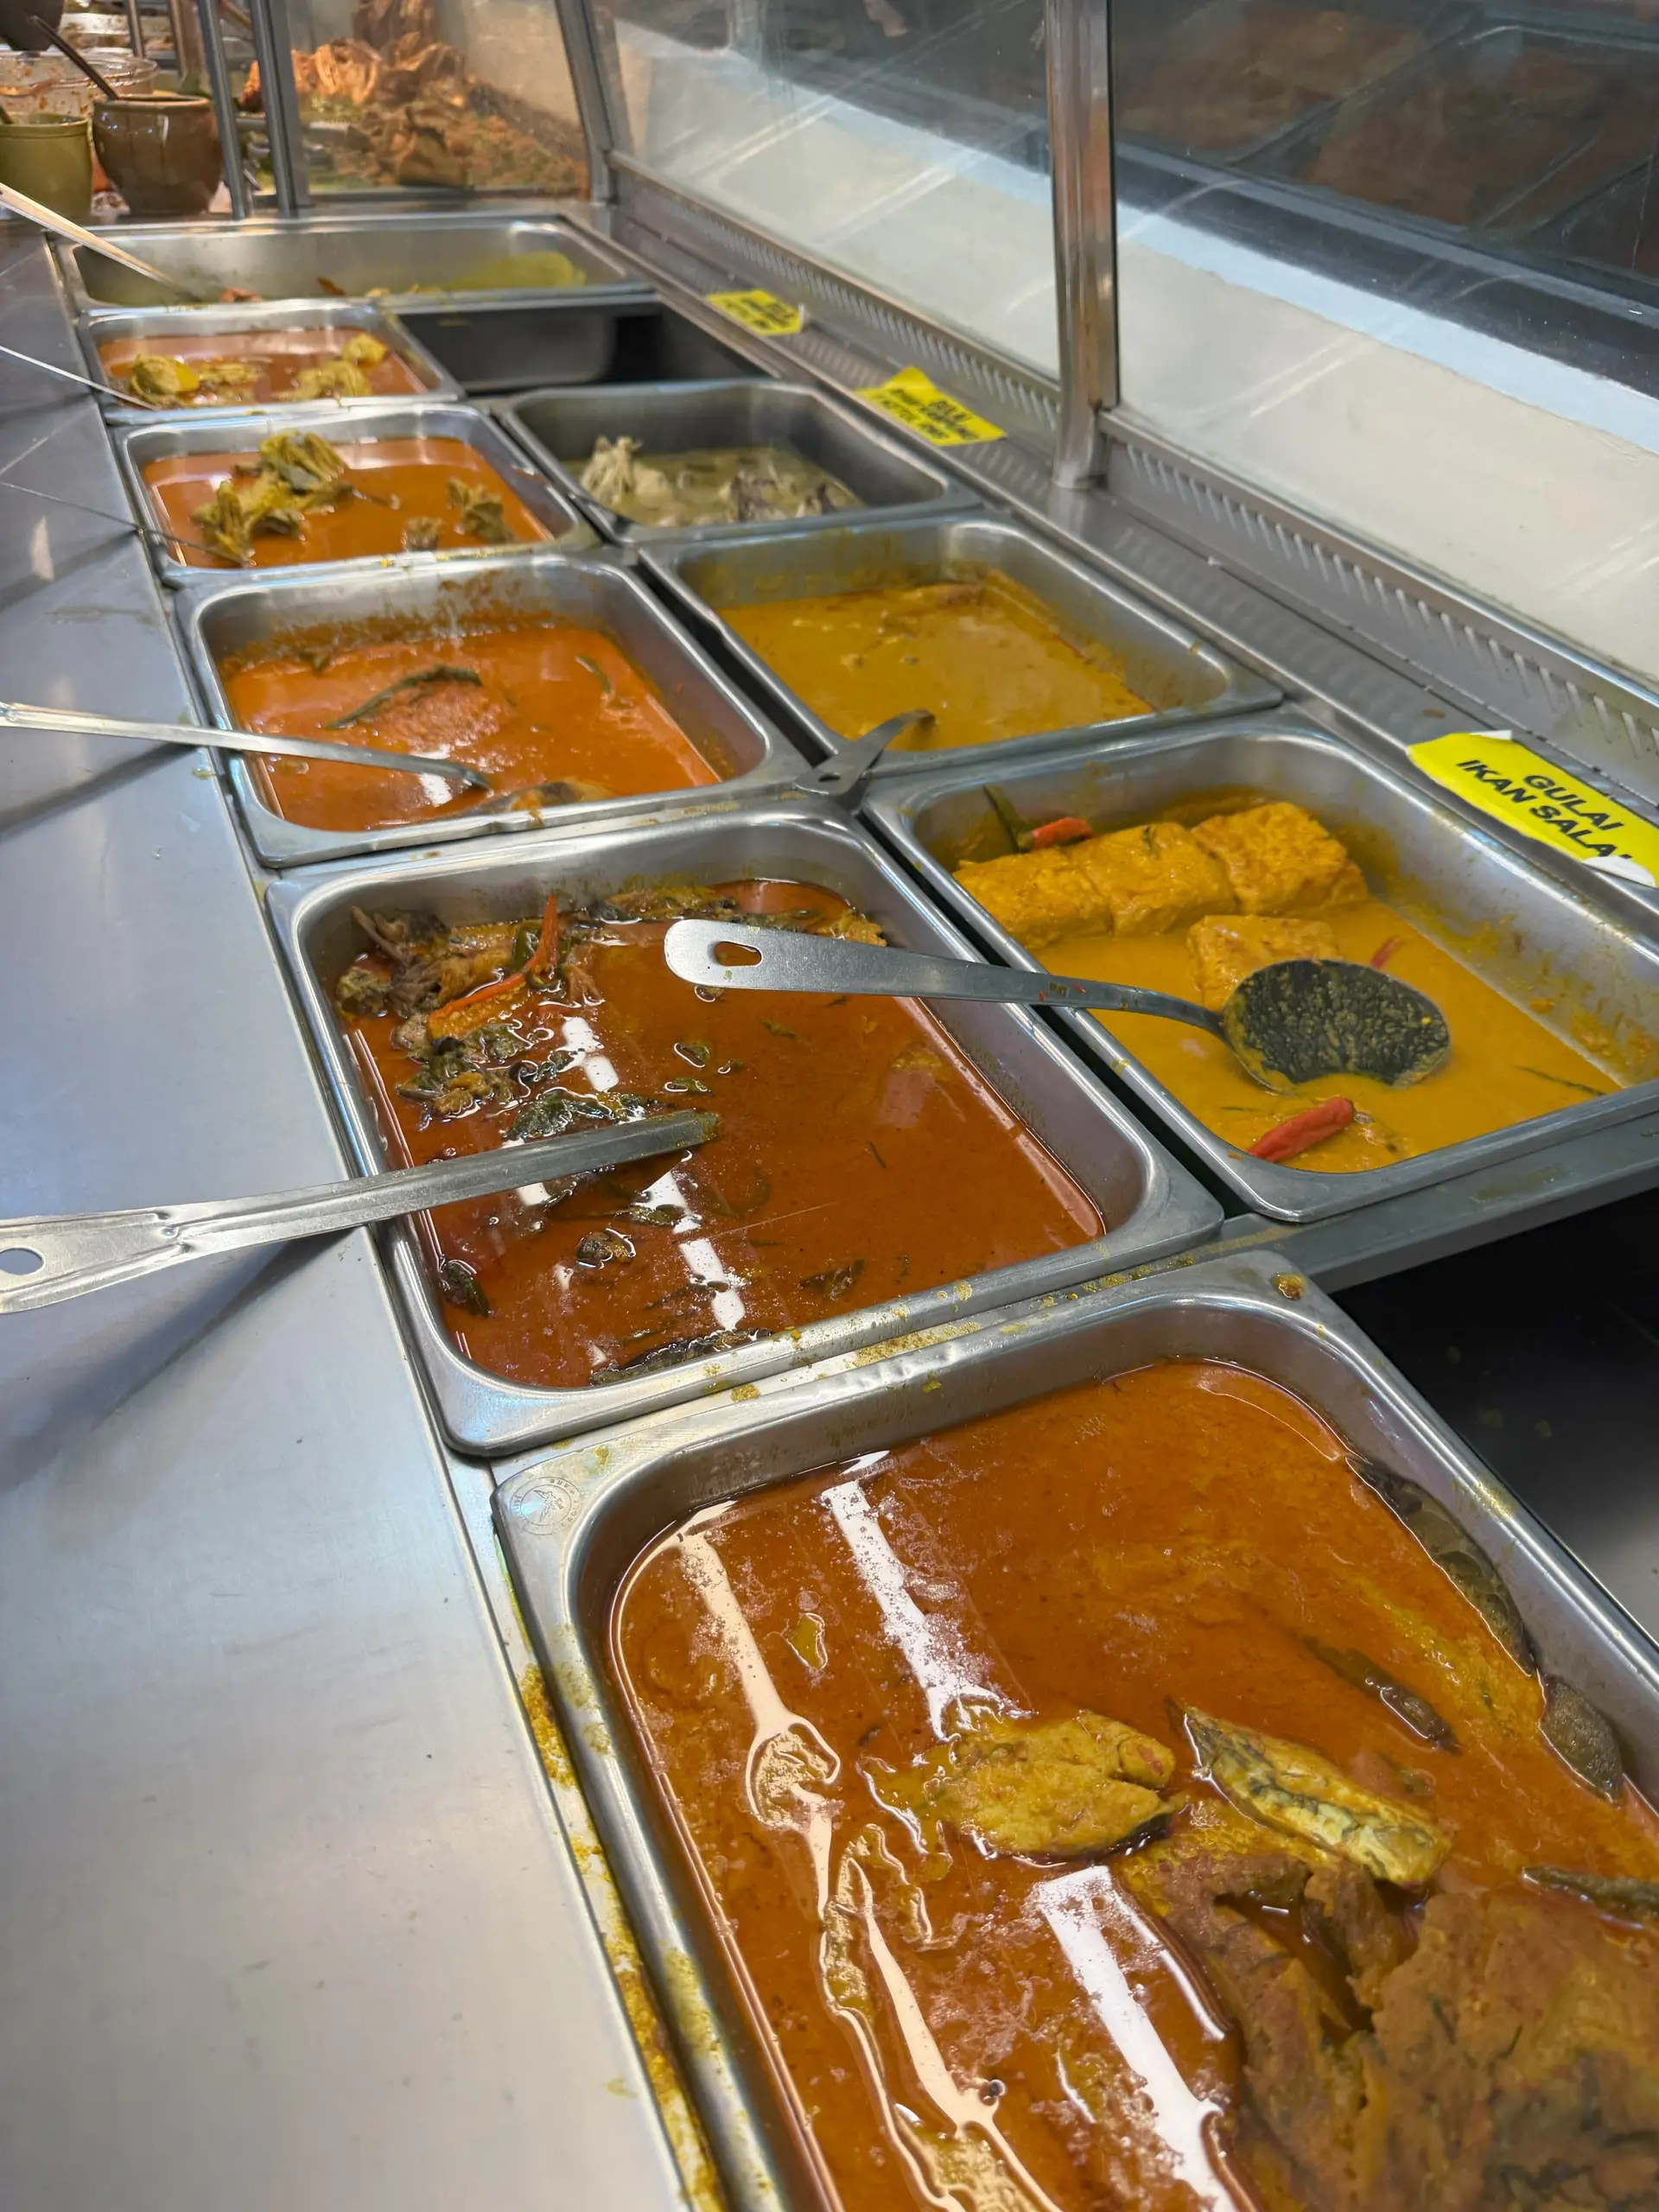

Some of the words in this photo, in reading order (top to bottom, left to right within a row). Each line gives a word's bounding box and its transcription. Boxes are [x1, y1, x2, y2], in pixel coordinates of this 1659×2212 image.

[1456, 760, 1538, 804] IKAN
[1529, 805, 1632, 859] SALA
[1523, 774, 1624, 831] GULAI
